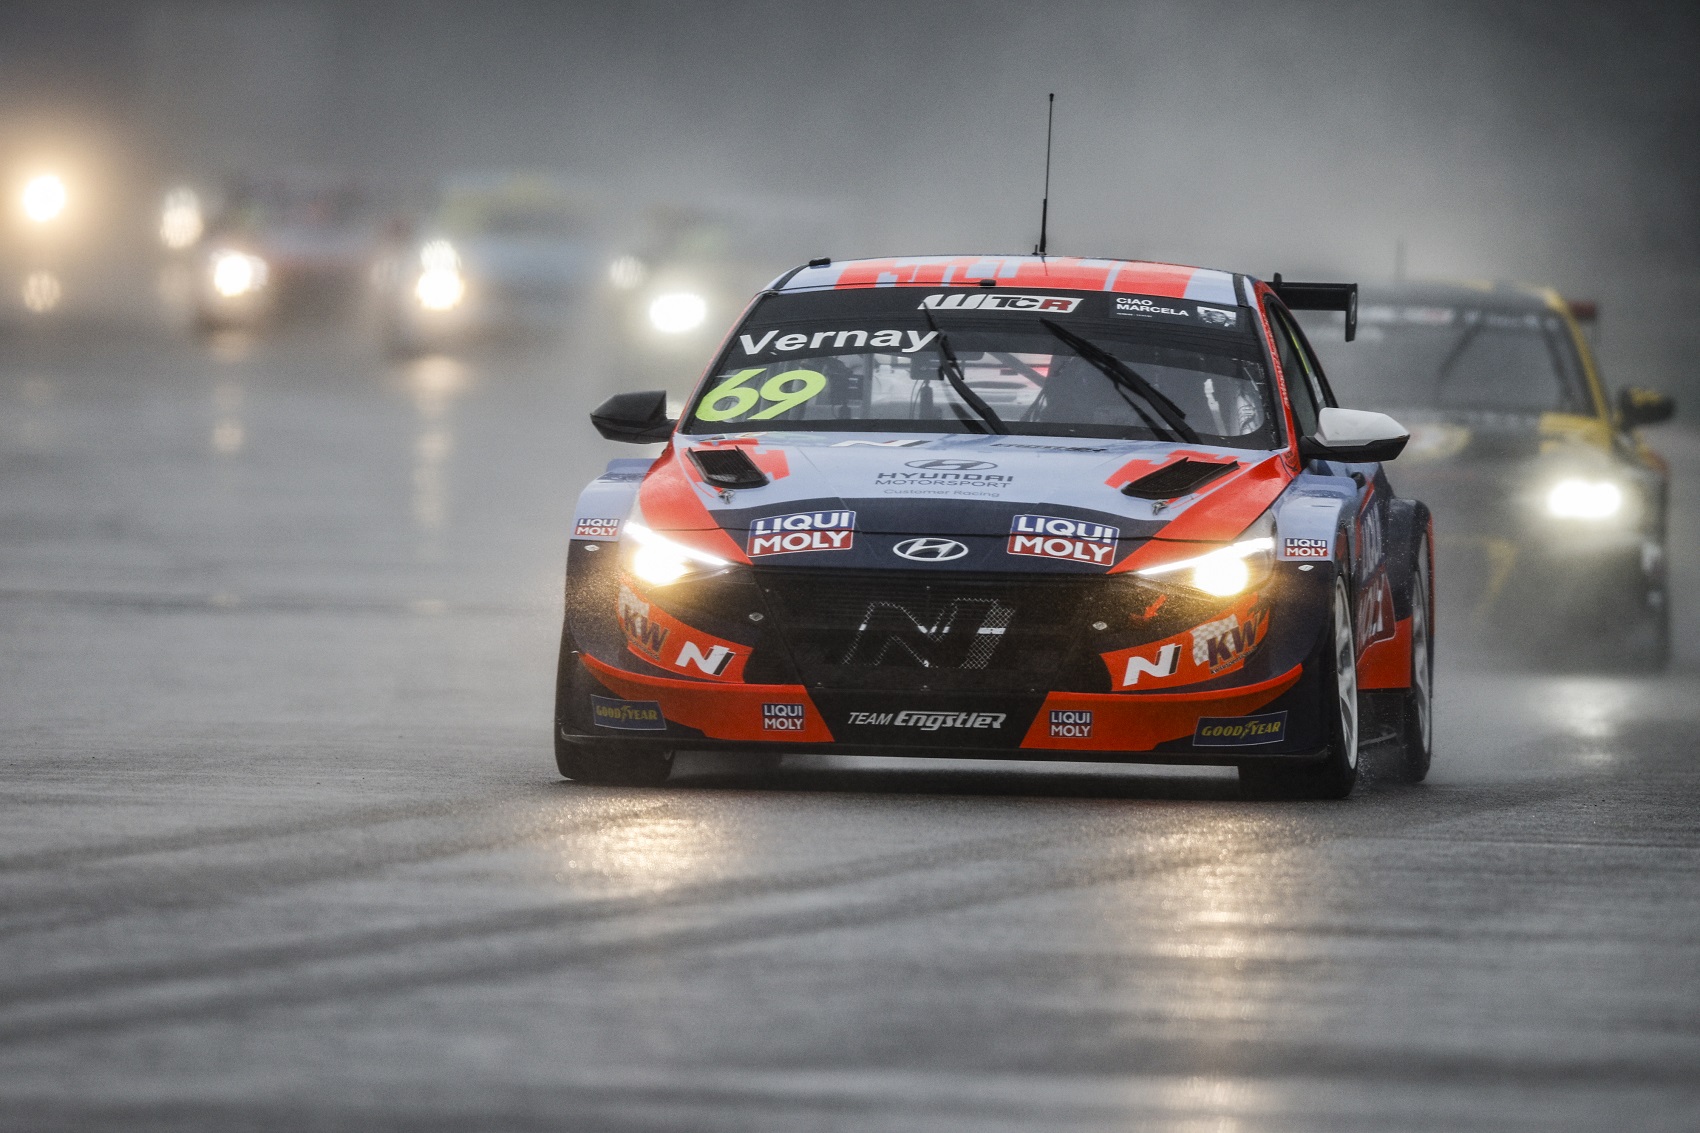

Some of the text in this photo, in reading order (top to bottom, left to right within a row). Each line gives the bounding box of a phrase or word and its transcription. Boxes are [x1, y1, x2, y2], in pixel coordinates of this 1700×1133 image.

[917, 294, 1080, 313] WTCR
[1116, 297, 1153, 306] CIAO
[1116, 304, 1189, 316] MARCELA
[739, 329, 939, 356] Vernay
[695, 368, 827, 422] 69
[877, 472, 1014, 481] HYUNDAI
[875, 480, 1011, 488] MOTORSPORT
[953, 490, 1000, 498] Racing
[579, 518, 619, 526] LIQUI
[755, 512, 850, 535] LIQUI
[576, 527, 617, 536] MOLY
[1017, 515, 1112, 544] LIQUI
[754, 530, 851, 556] MOLY
[1013, 535, 1112, 562] MOLY
[1286, 538, 1327, 548] LIQUI
[1286, 547, 1327, 556] MOLY
[624, 604, 671, 653] KW
[1206, 613, 1261, 668] KW
[596, 705, 658, 723] GOODYEAR
[764, 704, 803, 717] LIQUI
[764, 718, 803, 730] MOLY
[847, 712, 894, 726] TEAM
[1051, 711, 1090, 724] LIQUI
[1051, 725, 1091, 737] MOLY
[1201, 720, 1281, 739] GOODYEAR
